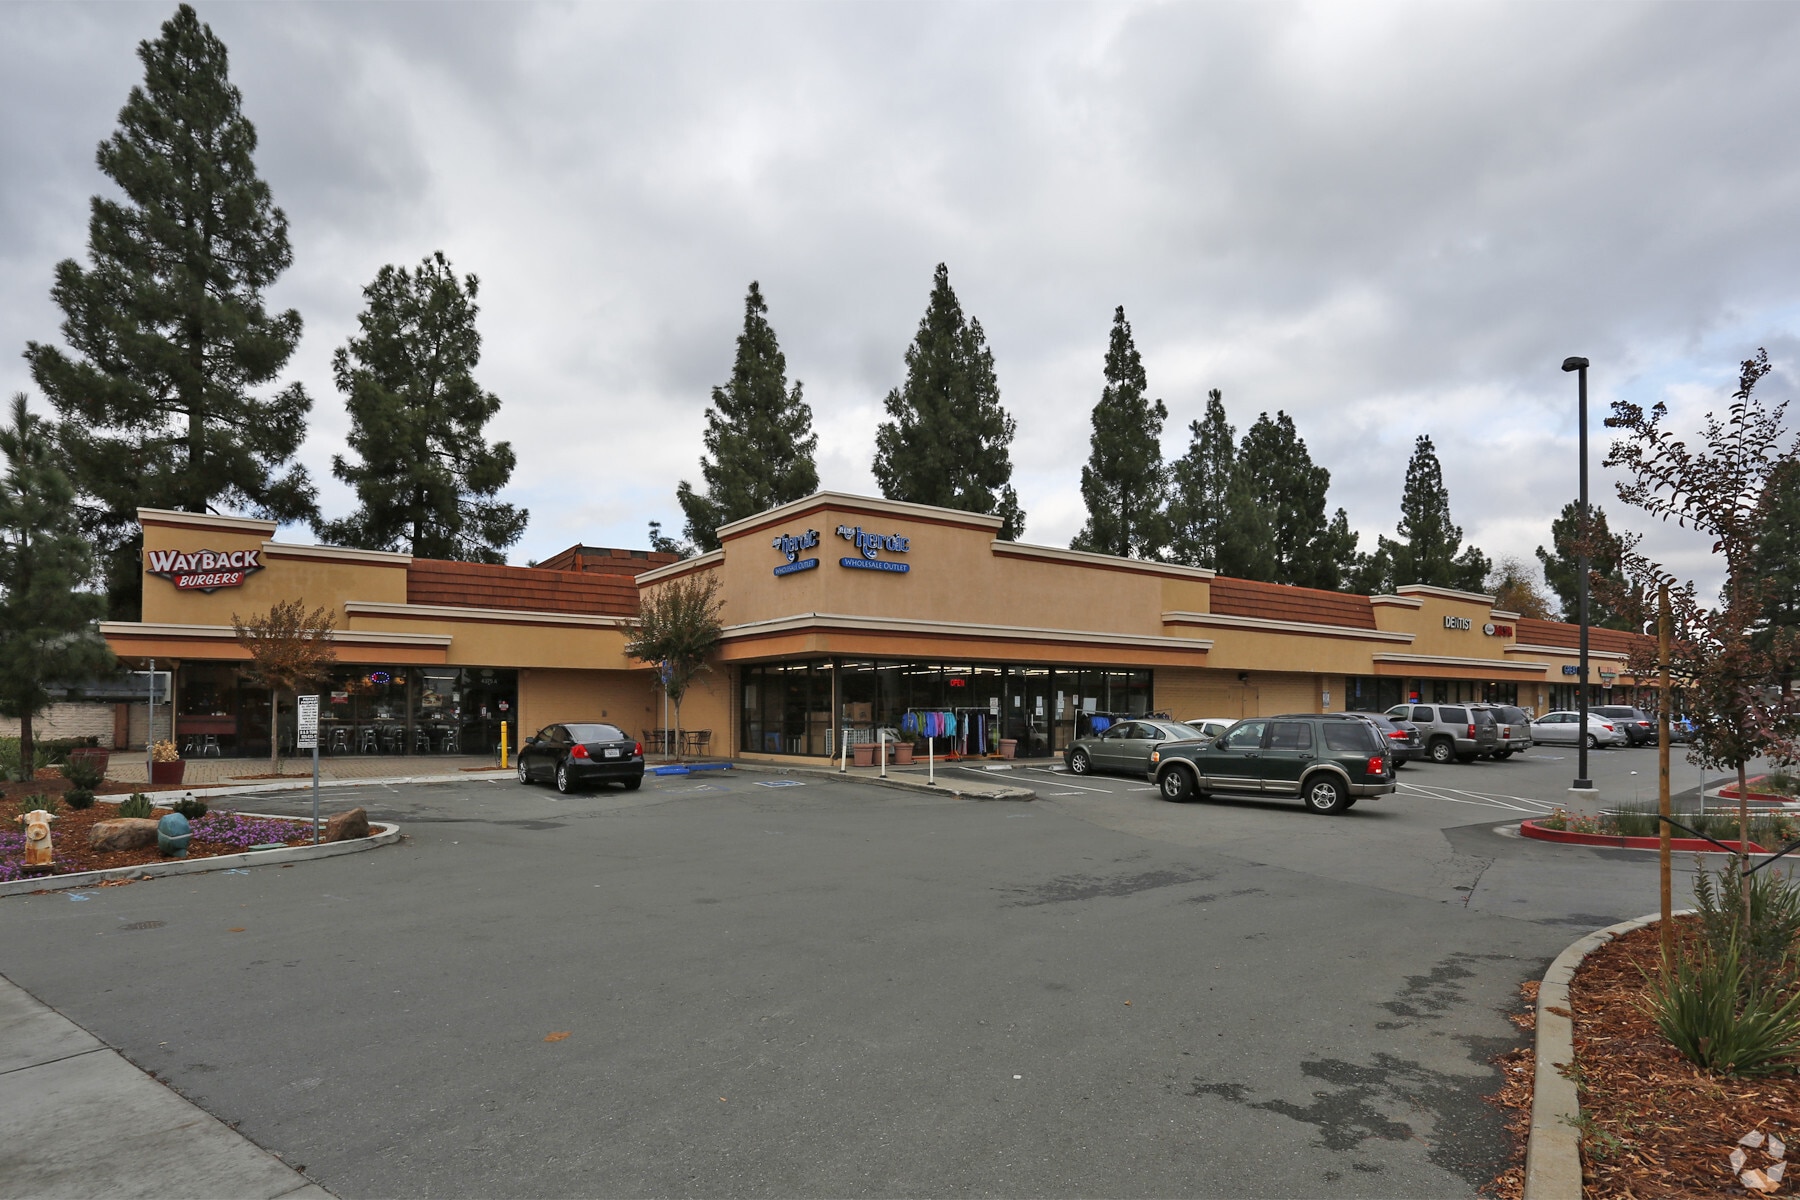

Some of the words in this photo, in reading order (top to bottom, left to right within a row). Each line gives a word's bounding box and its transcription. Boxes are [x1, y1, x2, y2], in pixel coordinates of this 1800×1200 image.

[148, 550, 260, 573] WAYBACK
[844, 558, 882, 569] WHOLESALE
[883, 562, 908, 572] OUTLET
[179, 573, 239, 587] BURGERS
[1445, 616, 1472, 630] DENTIST
[950, 679, 965, 687] OPEN
